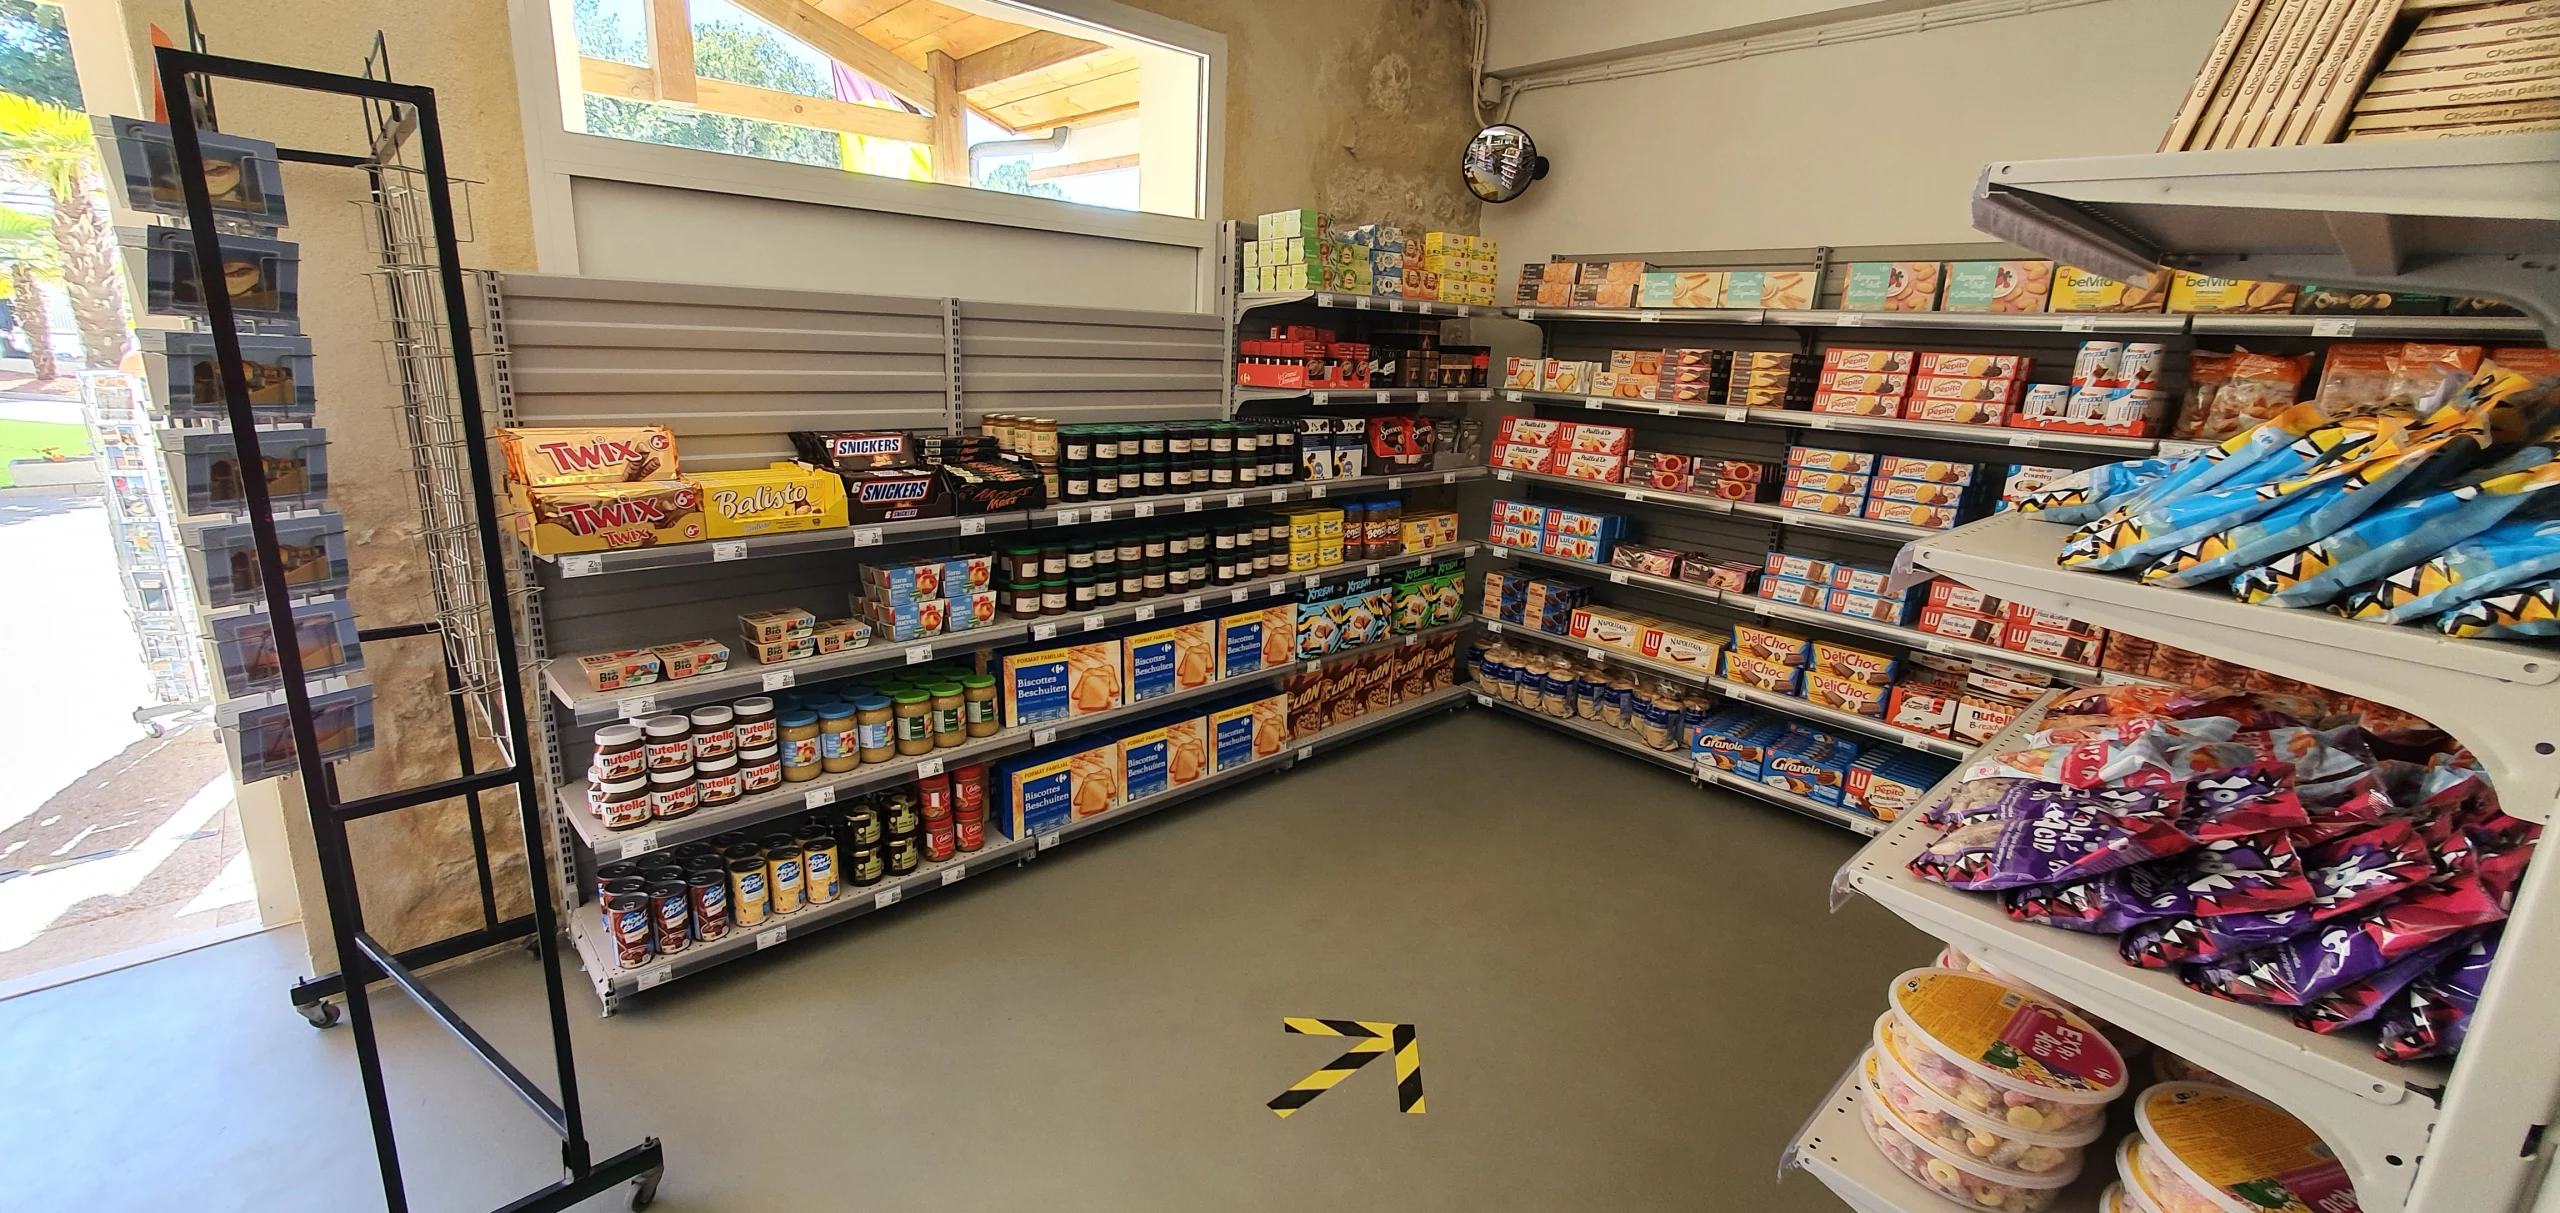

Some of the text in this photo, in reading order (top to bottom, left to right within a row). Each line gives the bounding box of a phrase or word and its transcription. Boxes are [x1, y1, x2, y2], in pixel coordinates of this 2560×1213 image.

[2244, 9, 2295, 96] Chocolat pâtissier
[2266, 7, 2317, 94] Chocolat pâtissier
[2291, 1, 2344, 90] Chocolat pâtissier
[2486, 43, 2557, 58] Chocolat
[2197, 13, 2243, 98] Chocolat pâtissier
[2221, 12, 2269, 98] Chocolat pâtissier
[2344, 39, 2373, 84] Chocolat
[2318, 43, 2349, 87] Chocolat
[2464, 67, 2531, 80] Chocolat
[2448, 88, 2513, 101] Chocolat
[2444, 109, 2509, 121] Chocolat
[1828, 351, 1840, 364] LU
[2083, 349, 2108, 358] maxi
[2125, 351, 2151, 360] maxi
[1510, 360, 1518, 371] LU
[1549, 363, 1557, 374] LU
[1923, 356, 1936, 369] LU
[1822, 373, 1834, 385] LU
[1917, 379, 1930, 391] LU
[1816, 394, 1829, 406] LU
[2078, 393, 2103, 403] maxi
[1911, 401, 1923, 413] LU
[1503, 420, 1513, 433] LU
[1562, 427, 1574, 440] LU
[825, 439, 899, 454] 6 SNICKERS
[1494, 445, 1504, 458] LU
[537, 436, 641, 472] Twix
[1557, 453, 1568, 467] LU
[1791, 450, 1803, 461] LU
[1882, 458, 1896, 471] LU
[1788, 471, 1799, 481] LU
[851, 481, 927, 501] 6 SNICKERS
[1873, 480, 1887, 492] LU
[712, 482, 808, 519] Balisto
[1783, 490, 1795, 501] LU
[987, 496, 1018, 510] Mars
[1495, 502, 1505, 515] LU
[1869, 500, 1882, 513] LU
[560, 495, 664, 535] Twix
[885, 511, 891, 519] 6
[1548, 511, 1560, 525] LU
[602, 528, 650, 546] Twix
[1492, 524, 1502, 537] LU
[1546, 534, 1557, 548] LU
[1770, 556, 1782, 568] LU
[1836, 569, 1850, 583] LU
[1763, 579, 1775, 592] LU
[1832, 593, 1845, 606] LU
[1934, 586, 1949, 600] LU
[2017, 603, 2033, 618] LU
[1244, 614, 1261, 622] FAMILIAL
[1574, 614, 1589, 631] LU
[1924, 612, 1940, 626] LU
[1134, 632, 1172, 644] FORMAT FAMILIAL
[1227, 634, 1254, 645] Biscottes
[1646, 632, 1660, 650] LU
[1741, 630, 1795, 653] DéliChoc
[2011, 629, 2028, 643] LU
[1227, 642, 1261, 654] Beschuiten
[1433, 641, 1456, 665] LION
[1135, 655, 1166, 667] Biscottes
[1401, 650, 1425, 674] LION
[1821, 647, 1881, 671] DéliChoc
[1135, 662, 1173, 677] Beschuiten
[1364, 659, 1391, 687] LION
[1732, 655, 1785, 679] DéliChoc
[1018, 676, 1056, 688] Biscottes
[1331, 668, 1357, 696] LION
[1813, 675, 1872, 700] DéliChoc
[1983, 677, 2008, 687] nutella
[1018, 685, 1067, 698] Beschuiten
[1293, 681, 1322, 707] LION
[1234, 708, 1251, 717] FAMILIAL
[1972, 710, 2017, 726] nutell
[739, 720, 775, 735] nutella
[1218, 728, 1245, 740] Biscottes
[698, 730, 735, 745] nutella
[1127, 732, 1166, 747] FORMAT FAMILIAL
[1218, 735, 1251, 748] Beschuiten
[1699, 734, 1744, 751] Granola
[648, 742, 688, 756] nutella
[603, 750, 643, 766] nutella
[1127, 754, 1159, 767] Biscottes
[746, 762, 780, 778] nutella
[1024, 762, 1068, 779] FORMAT FAMILIAL
[1128, 761, 1166, 777] Beschuiten
[1771, 757, 1821, 775] Granola
[699, 777, 737, 790] nutella
[1850, 772, 1867, 790] LU
[660, 783, 696, 803] nutella
[1025, 786, 1060, 802] Biscottes
[605, 799, 646, 814] nutella
[1025, 793, 1069, 812] Beschuiten
[2035, 1030, 2061, 1057] ACID
